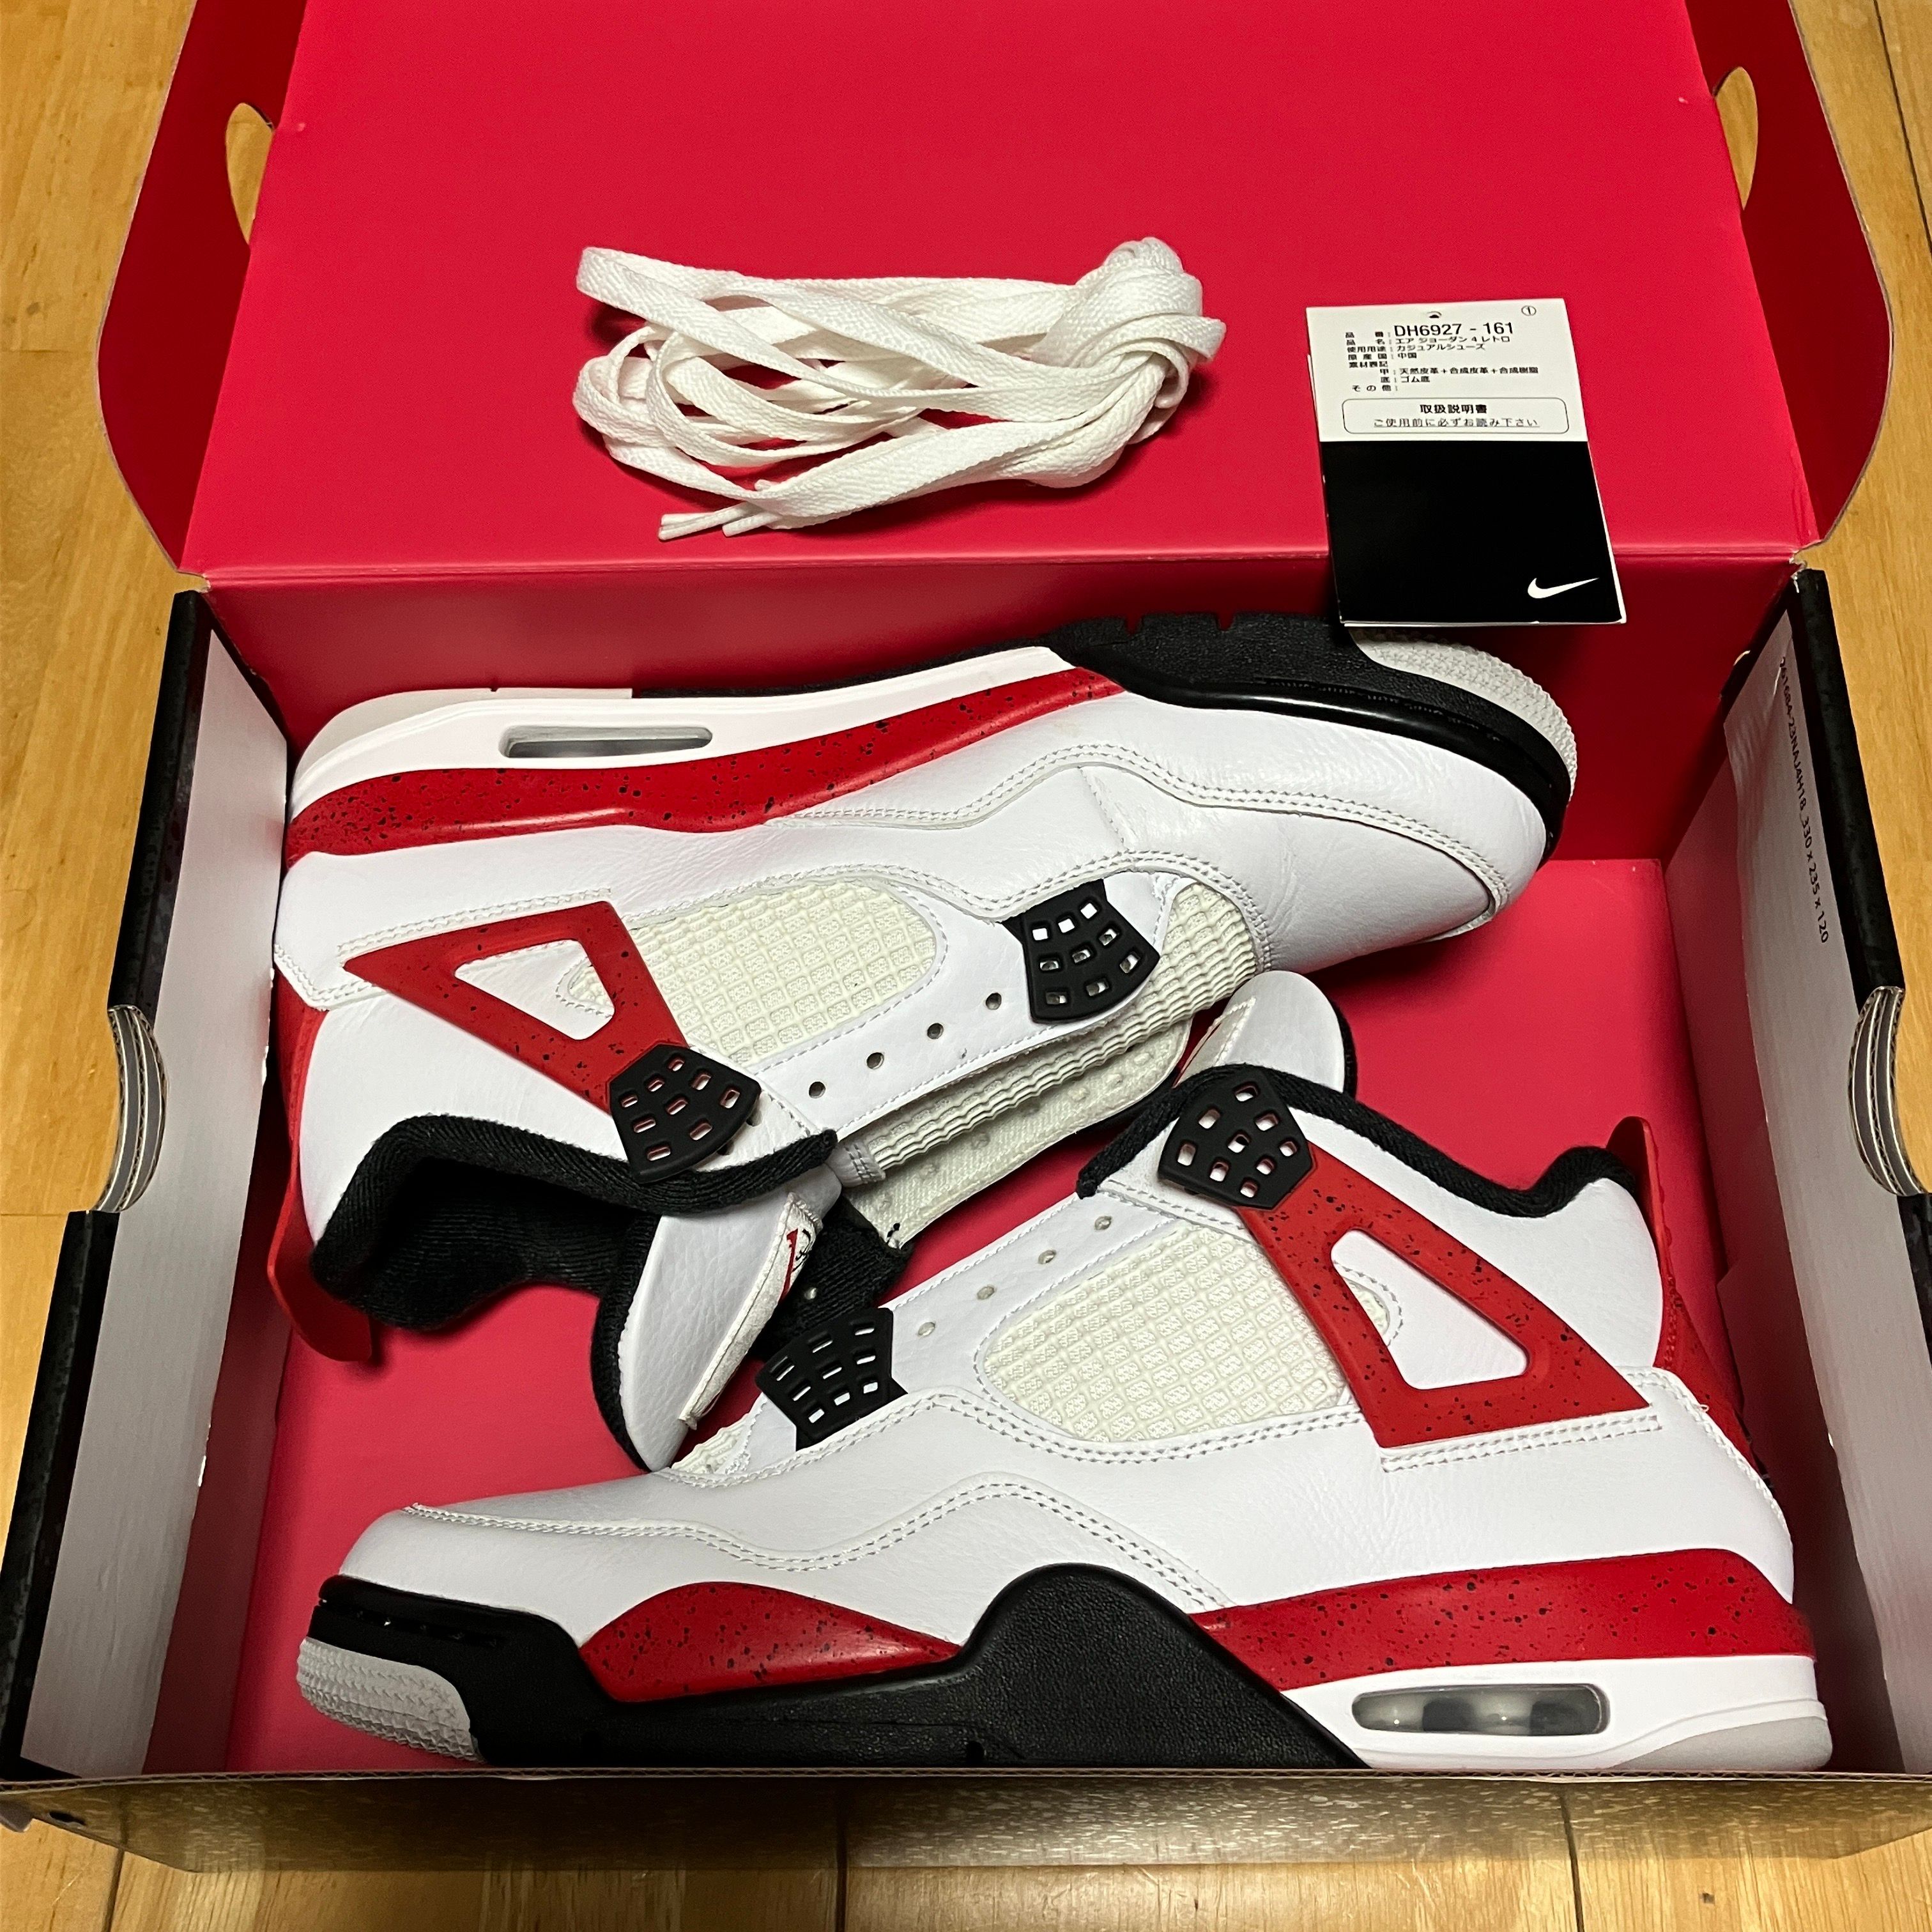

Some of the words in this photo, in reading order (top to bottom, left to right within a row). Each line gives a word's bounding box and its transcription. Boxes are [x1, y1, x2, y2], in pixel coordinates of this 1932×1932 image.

[1394, 323, 1462, 337] DH6927
[1483, 322, 1513, 334] 161
[1420, 404, 1487, 414] 取扱説明書
[1809, 862, 1820, 894] 235
[1818, 910, 1829, 944] 120
